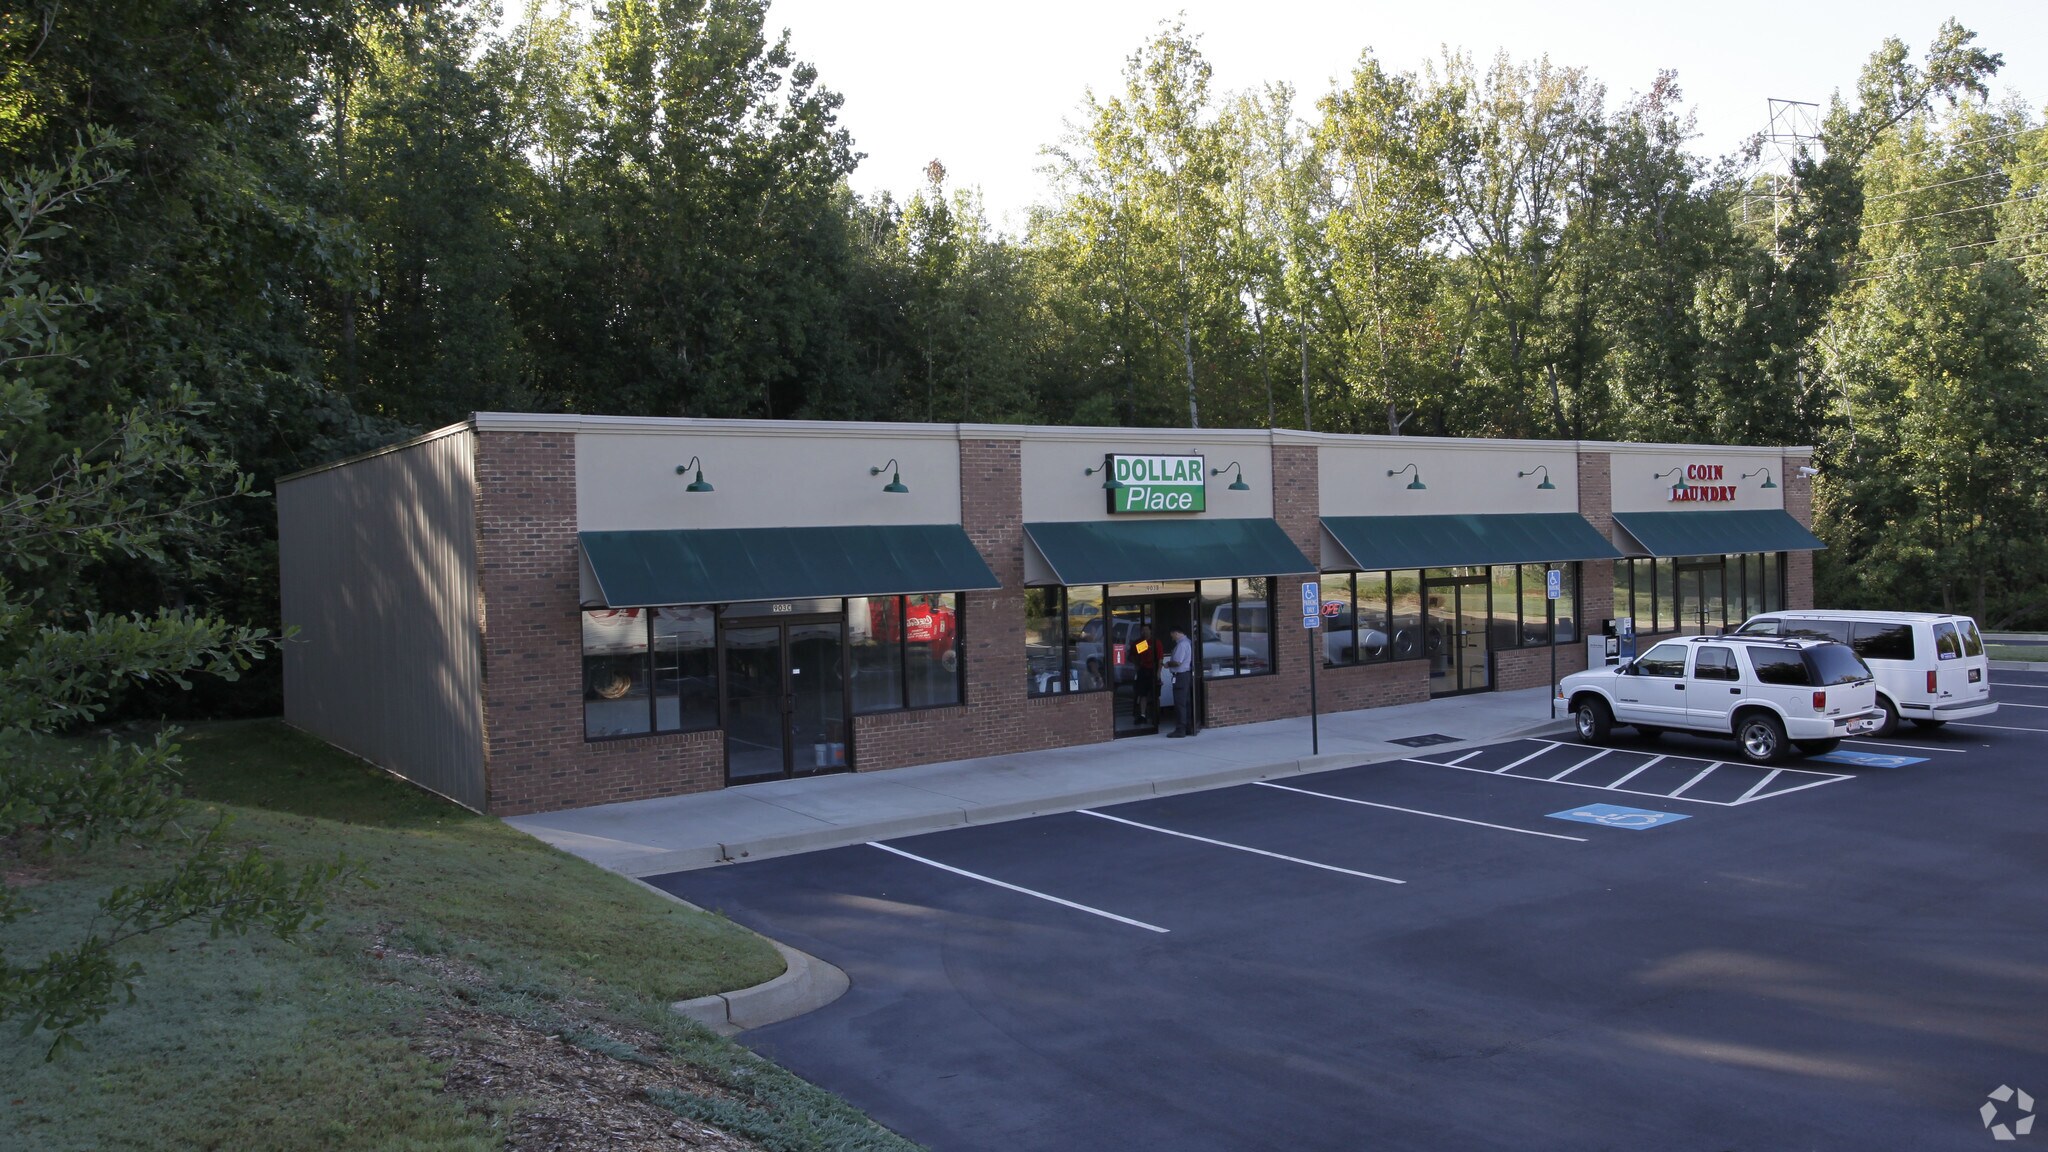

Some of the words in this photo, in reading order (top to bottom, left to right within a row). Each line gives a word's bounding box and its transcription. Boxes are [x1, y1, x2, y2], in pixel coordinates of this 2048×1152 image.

[1116, 458, 1202, 481] DOLLAR
[1687, 464, 1723, 480] COIN
[1126, 487, 1192, 510] Place
[1672, 486, 1737, 501] LAUNDRY
